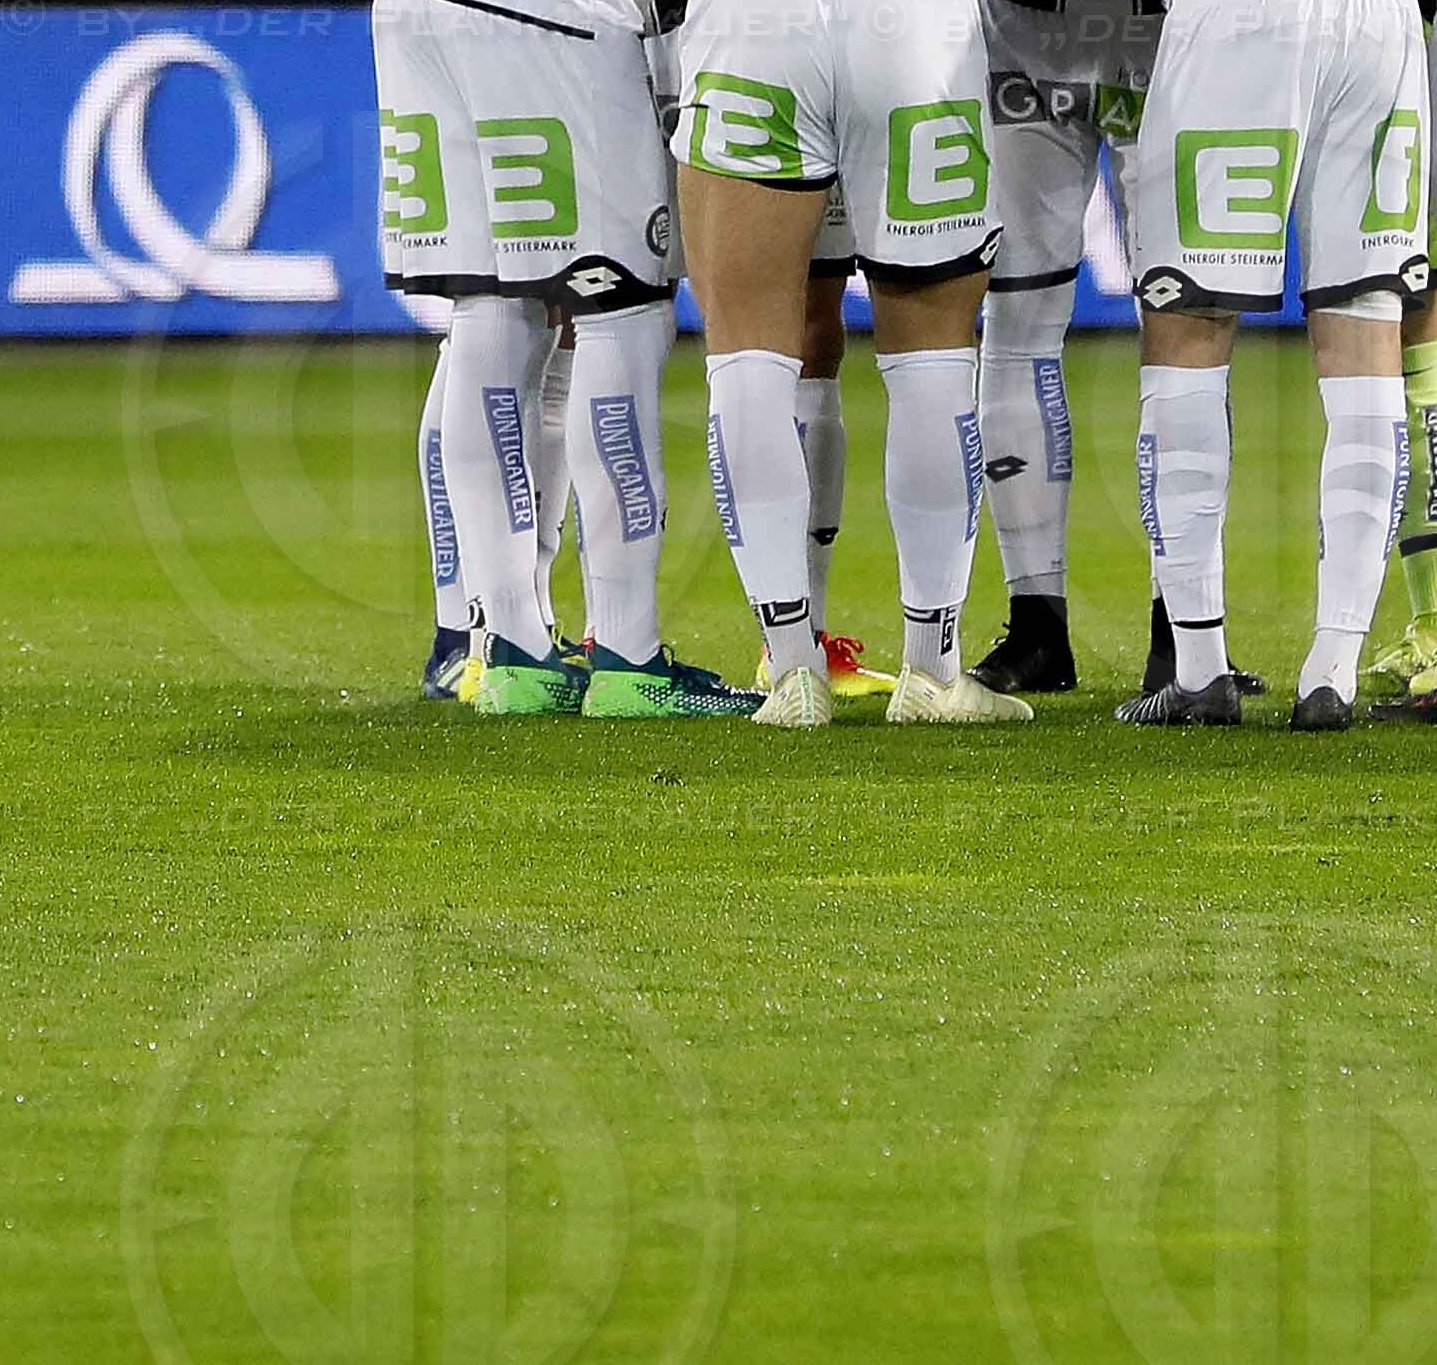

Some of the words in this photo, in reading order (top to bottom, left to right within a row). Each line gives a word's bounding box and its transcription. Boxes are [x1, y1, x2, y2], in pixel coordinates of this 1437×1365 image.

[886, 222, 934, 237] ENERGIE
[502, 240, 577, 254] STEIERMARK
[1182, 252, 1226, 265] ENERGIE
[1230, 253, 1285, 265] STEIERMA
[488, 391, 532, 526] PUNTIGAMER
[596, 400, 657, 535] PUNTIGAMER
